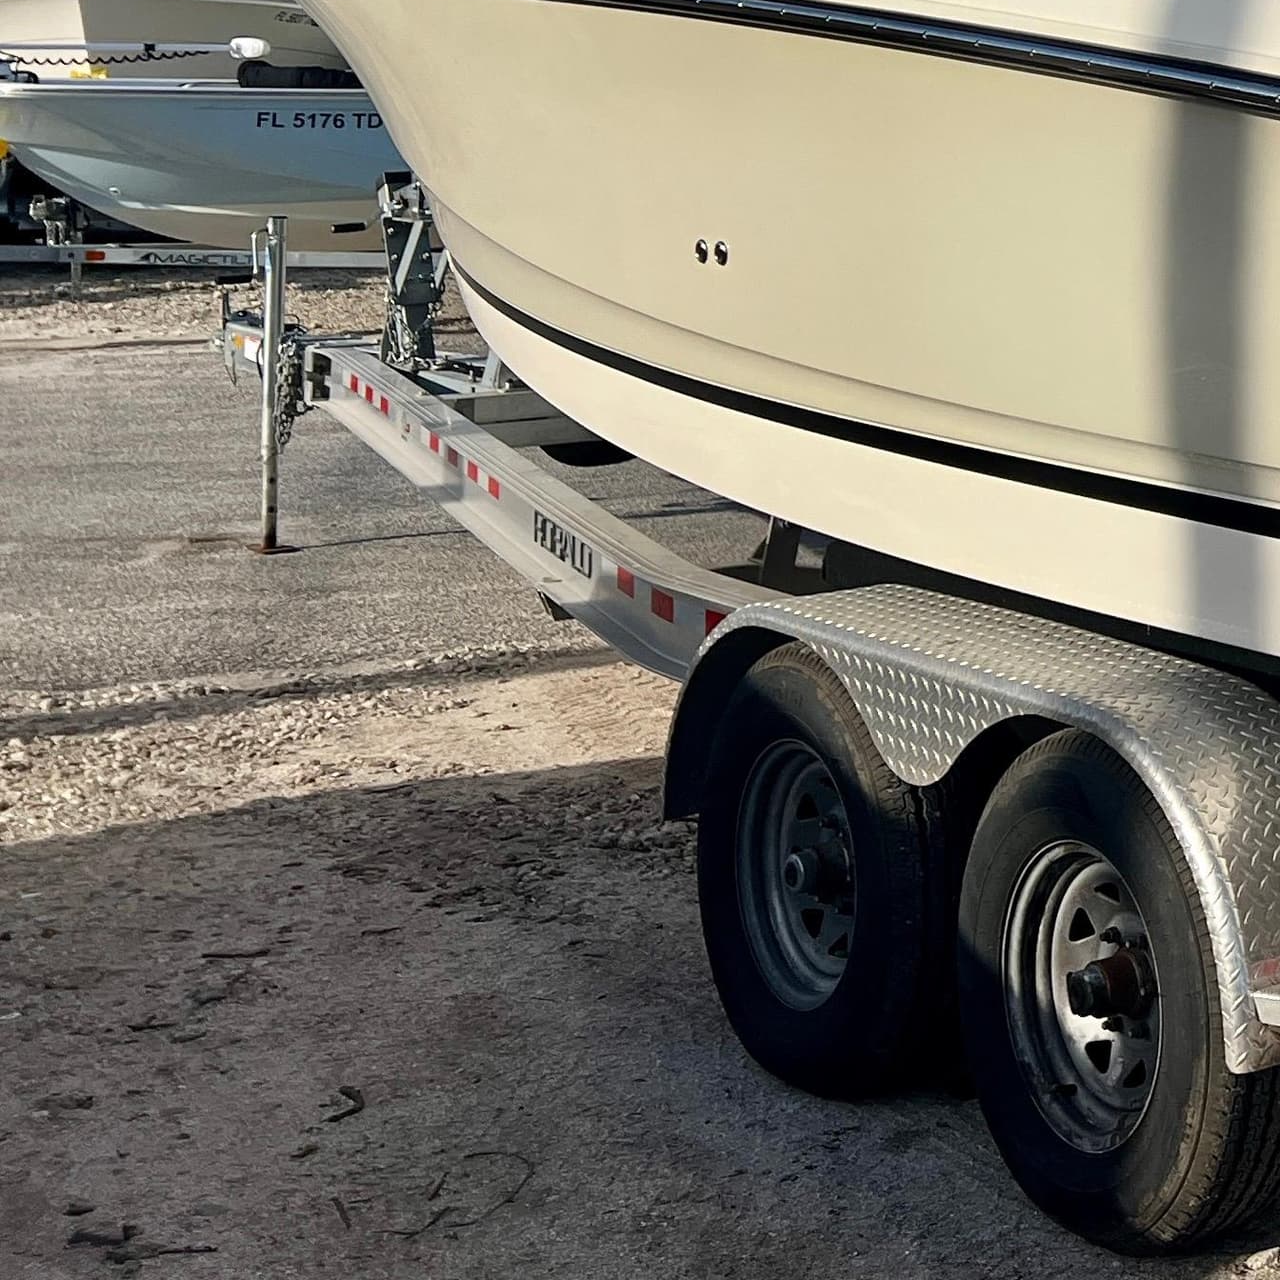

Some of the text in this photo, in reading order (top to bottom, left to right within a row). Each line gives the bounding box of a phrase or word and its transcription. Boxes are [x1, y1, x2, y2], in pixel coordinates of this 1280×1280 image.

[256, 111, 384, 129] FL 5176 TD
[534, 509, 593, 579] ROBALO
